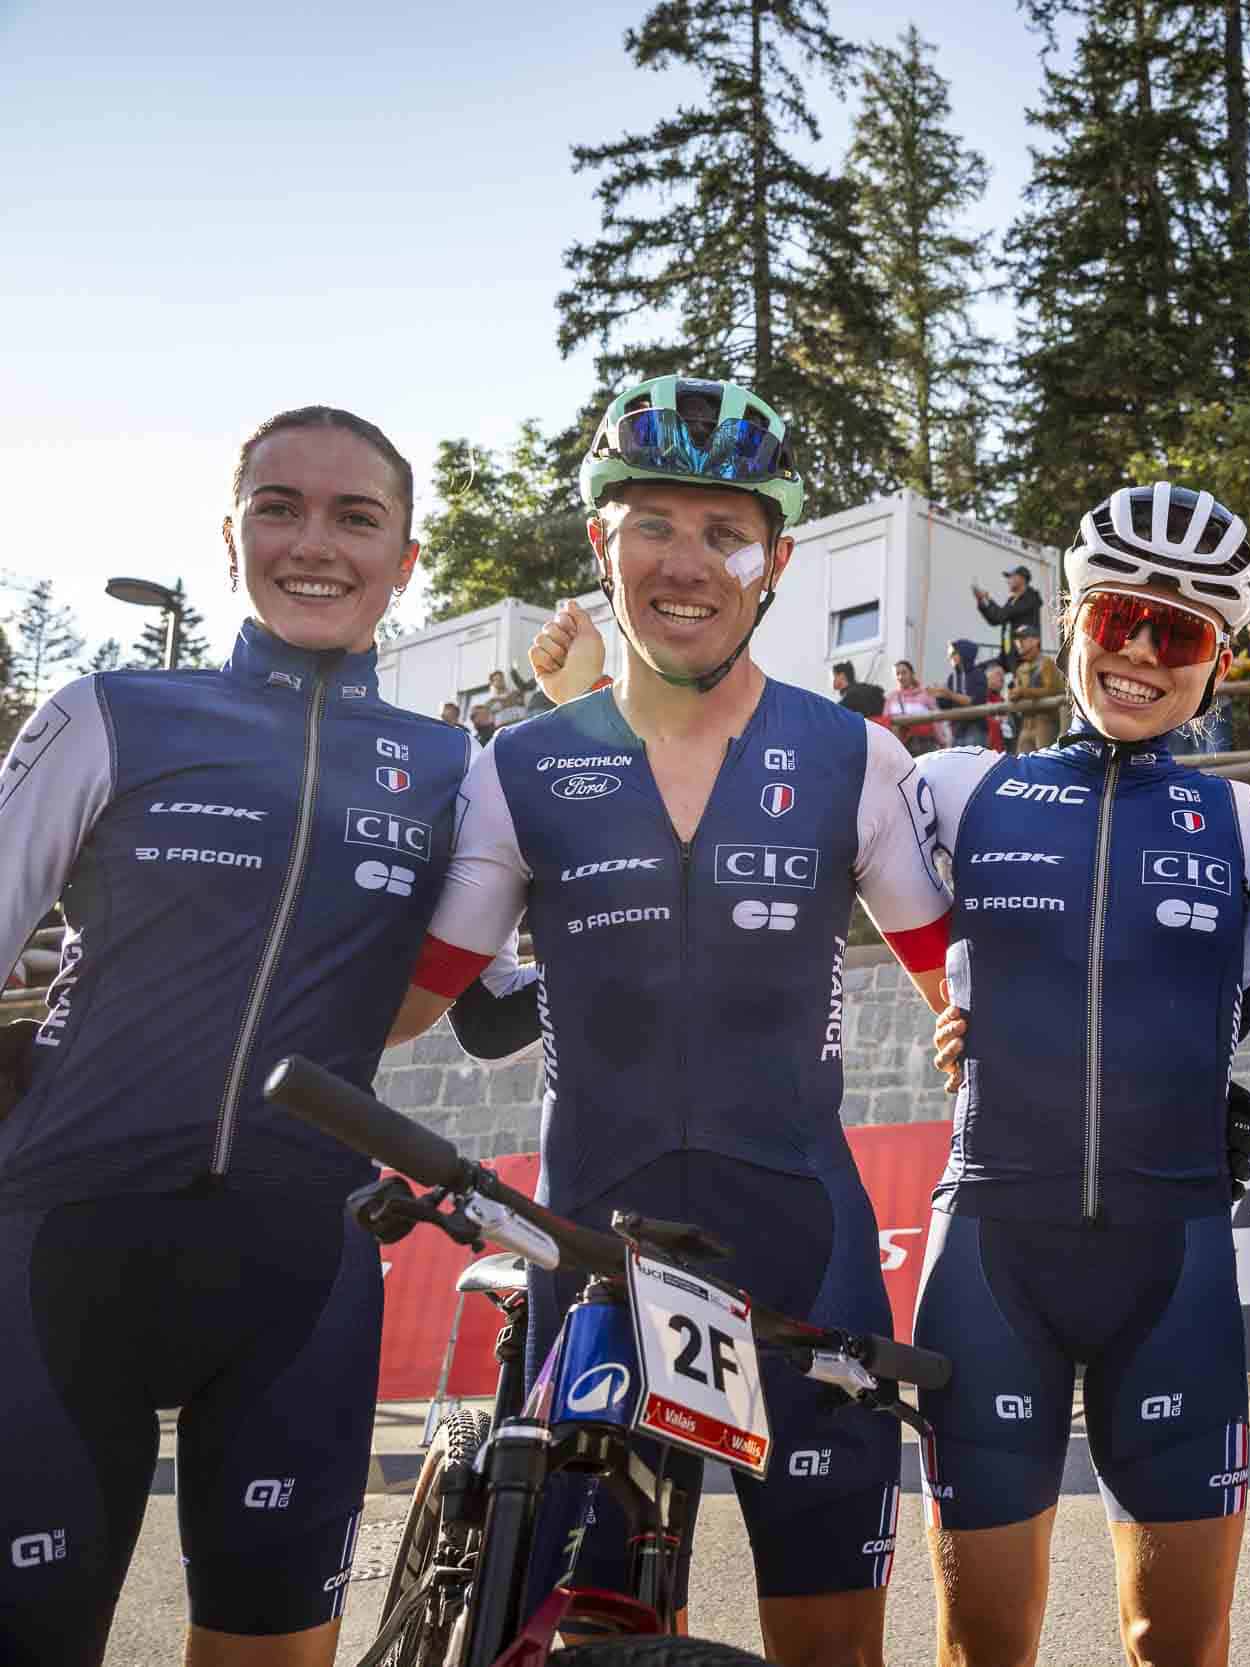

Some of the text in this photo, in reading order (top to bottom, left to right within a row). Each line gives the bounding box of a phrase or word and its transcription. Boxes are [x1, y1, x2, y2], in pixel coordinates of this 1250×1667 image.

[557, 755, 632, 769] DECATHLON
[564, 776, 609, 798] Ford
[995, 779, 1090, 804] BMC
[150, 802, 269, 821] LOOK
[356, 816, 426, 850] CIC
[167, 849, 262, 868] FACOM
[561, 857, 664, 882] LOOK
[727, 852, 809, 880] CIC
[970, 852, 1065, 865] LOOK
[1153, 857, 1226, 885] CIC
[983, 897, 1065, 912] FACOM
[587, 906, 670, 929] FACOM
[821, 936, 846, 1062] FRANCE
[668, 1314, 739, 1393] 2F
[664, 1405, 697, 1433] Valais
[732, 1434, 762, 1457] Wallis
